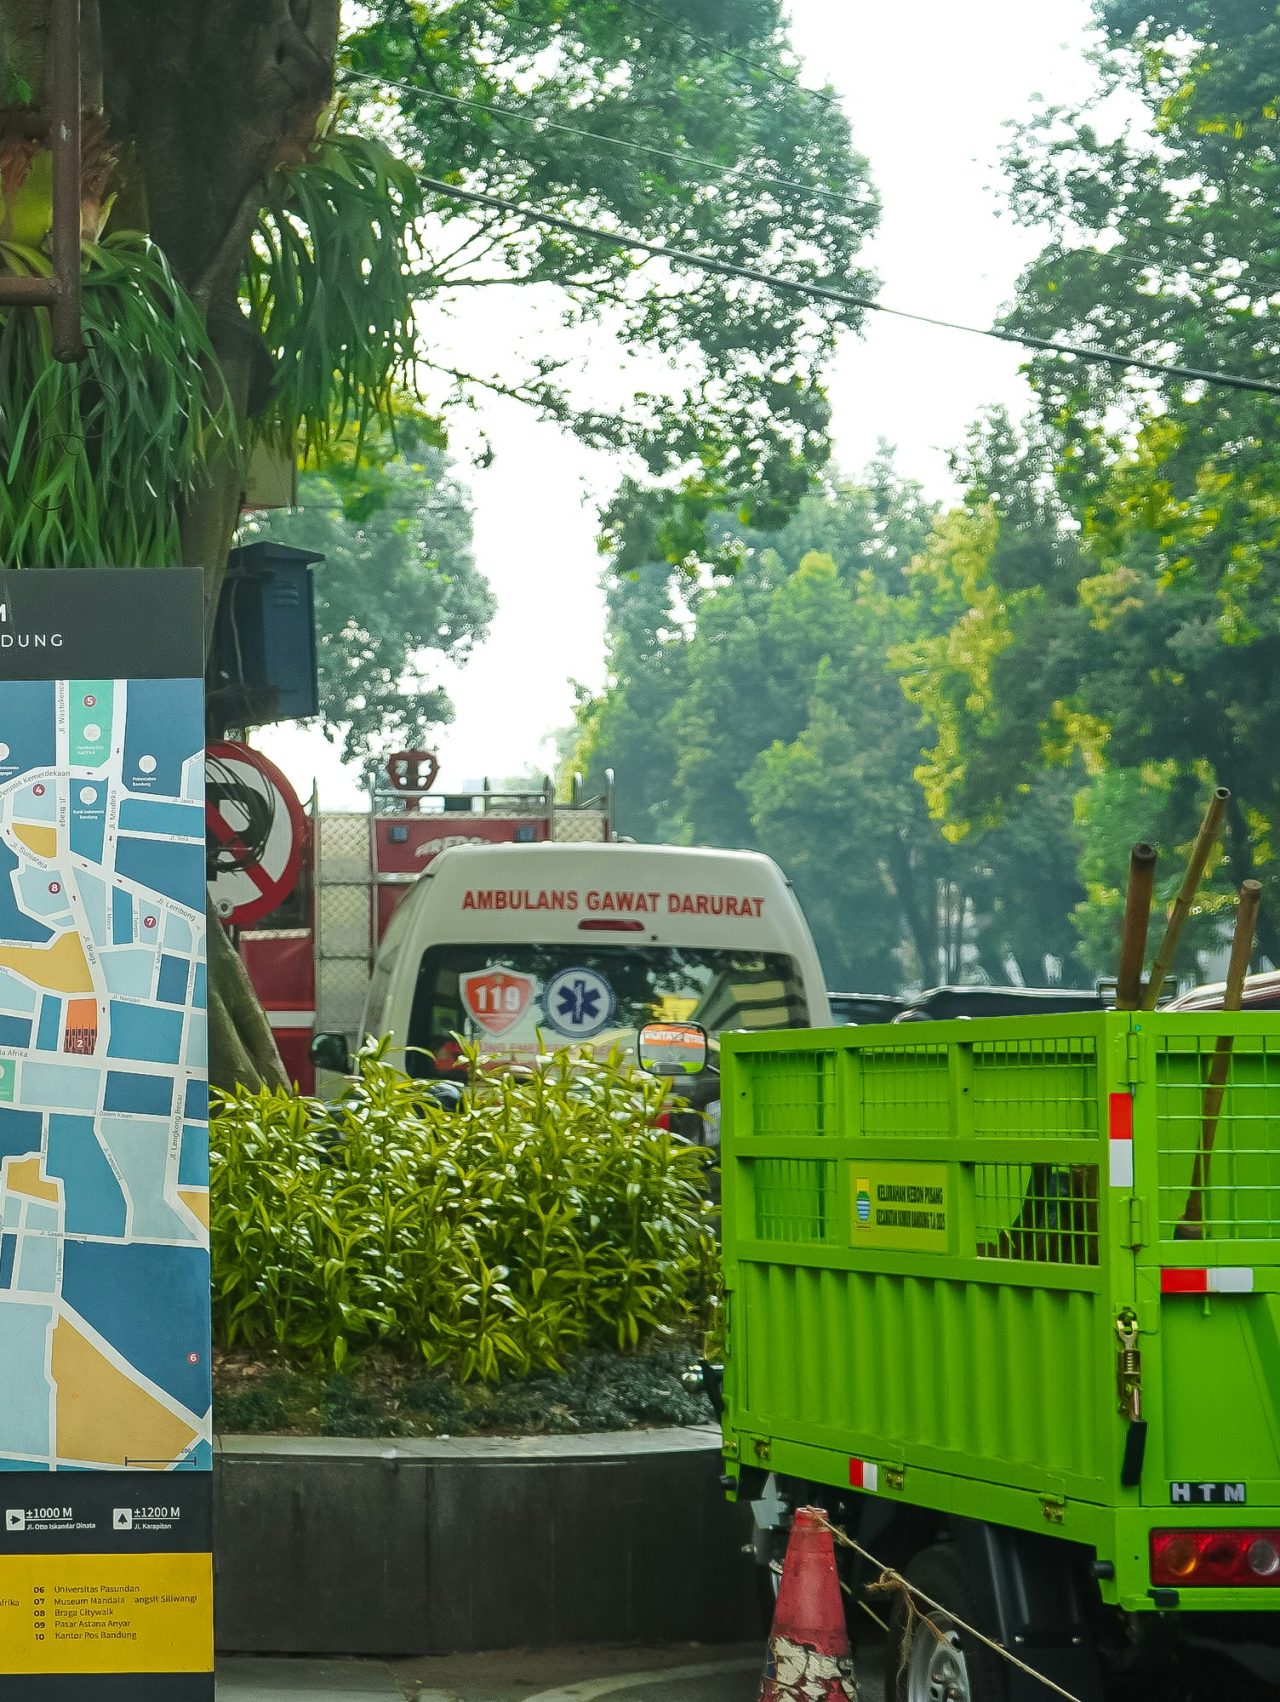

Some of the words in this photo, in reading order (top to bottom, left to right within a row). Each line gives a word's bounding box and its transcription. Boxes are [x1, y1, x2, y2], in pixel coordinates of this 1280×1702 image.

[87, 697, 93, 705] 5
[23, 770, 70, 783] Kemerdekaan
[35, 786, 42, 794] 4
[109, 790, 117, 821] Merdeka
[19, 844, 48, 869] Suniaraja
[51, 884, 58, 892] 8
[462, 890, 578, 911] AMBULANS
[586, 891, 660, 912] GAWAT
[667, 893, 765, 917] DARURAT
[165, 900, 196, 922] Lembong
[147, 918, 154, 926] 7
[86, 943, 97, 965] Braga
[475, 985, 520, 1011] 119
[76, 1039, 84, 1048] 2
[7, 1049, 28, 1058] Afrika
[175, 1095, 183, 1115] Besar
[171, 1115, 181, 1151] Lengkong
[190, 1354, 197, 1362] 6
[1172, 1482, 1245, 1502] HTM
[26, 1508, 60, 1519] ±1000
[63, 1507, 72, 1518] M
[134, 1507, 168, 1518] ±1200
[170, 1507, 180, 1517] M
[142, 1523, 171, 1531] Karapitan
[33, 1586, 45, 1594] 06
[54, 1585, 99, 1594] Universitas
[100, 1585, 140, 1593] Pasundan
[33, 1598, 45, 1606] 07
[54, 1598, 89, 1606] Museum
[90, 1596, 125, 1605] Mandala
[160, 1594, 198, 1604] Siliwangi
[54, 1609, 78, 1618] Braga
[79, 1608, 114, 1617] Citywalk
[54, 1620, 78, 1628] Pasar
[78, 1620, 106, 1628] Astana
[108, 1620, 131, 1629] Anyar
[55, 1632, 82, 1640] Kantor
[84, 1631, 99, 1639] Pos
[100, 1630, 137, 1640] Bandung
